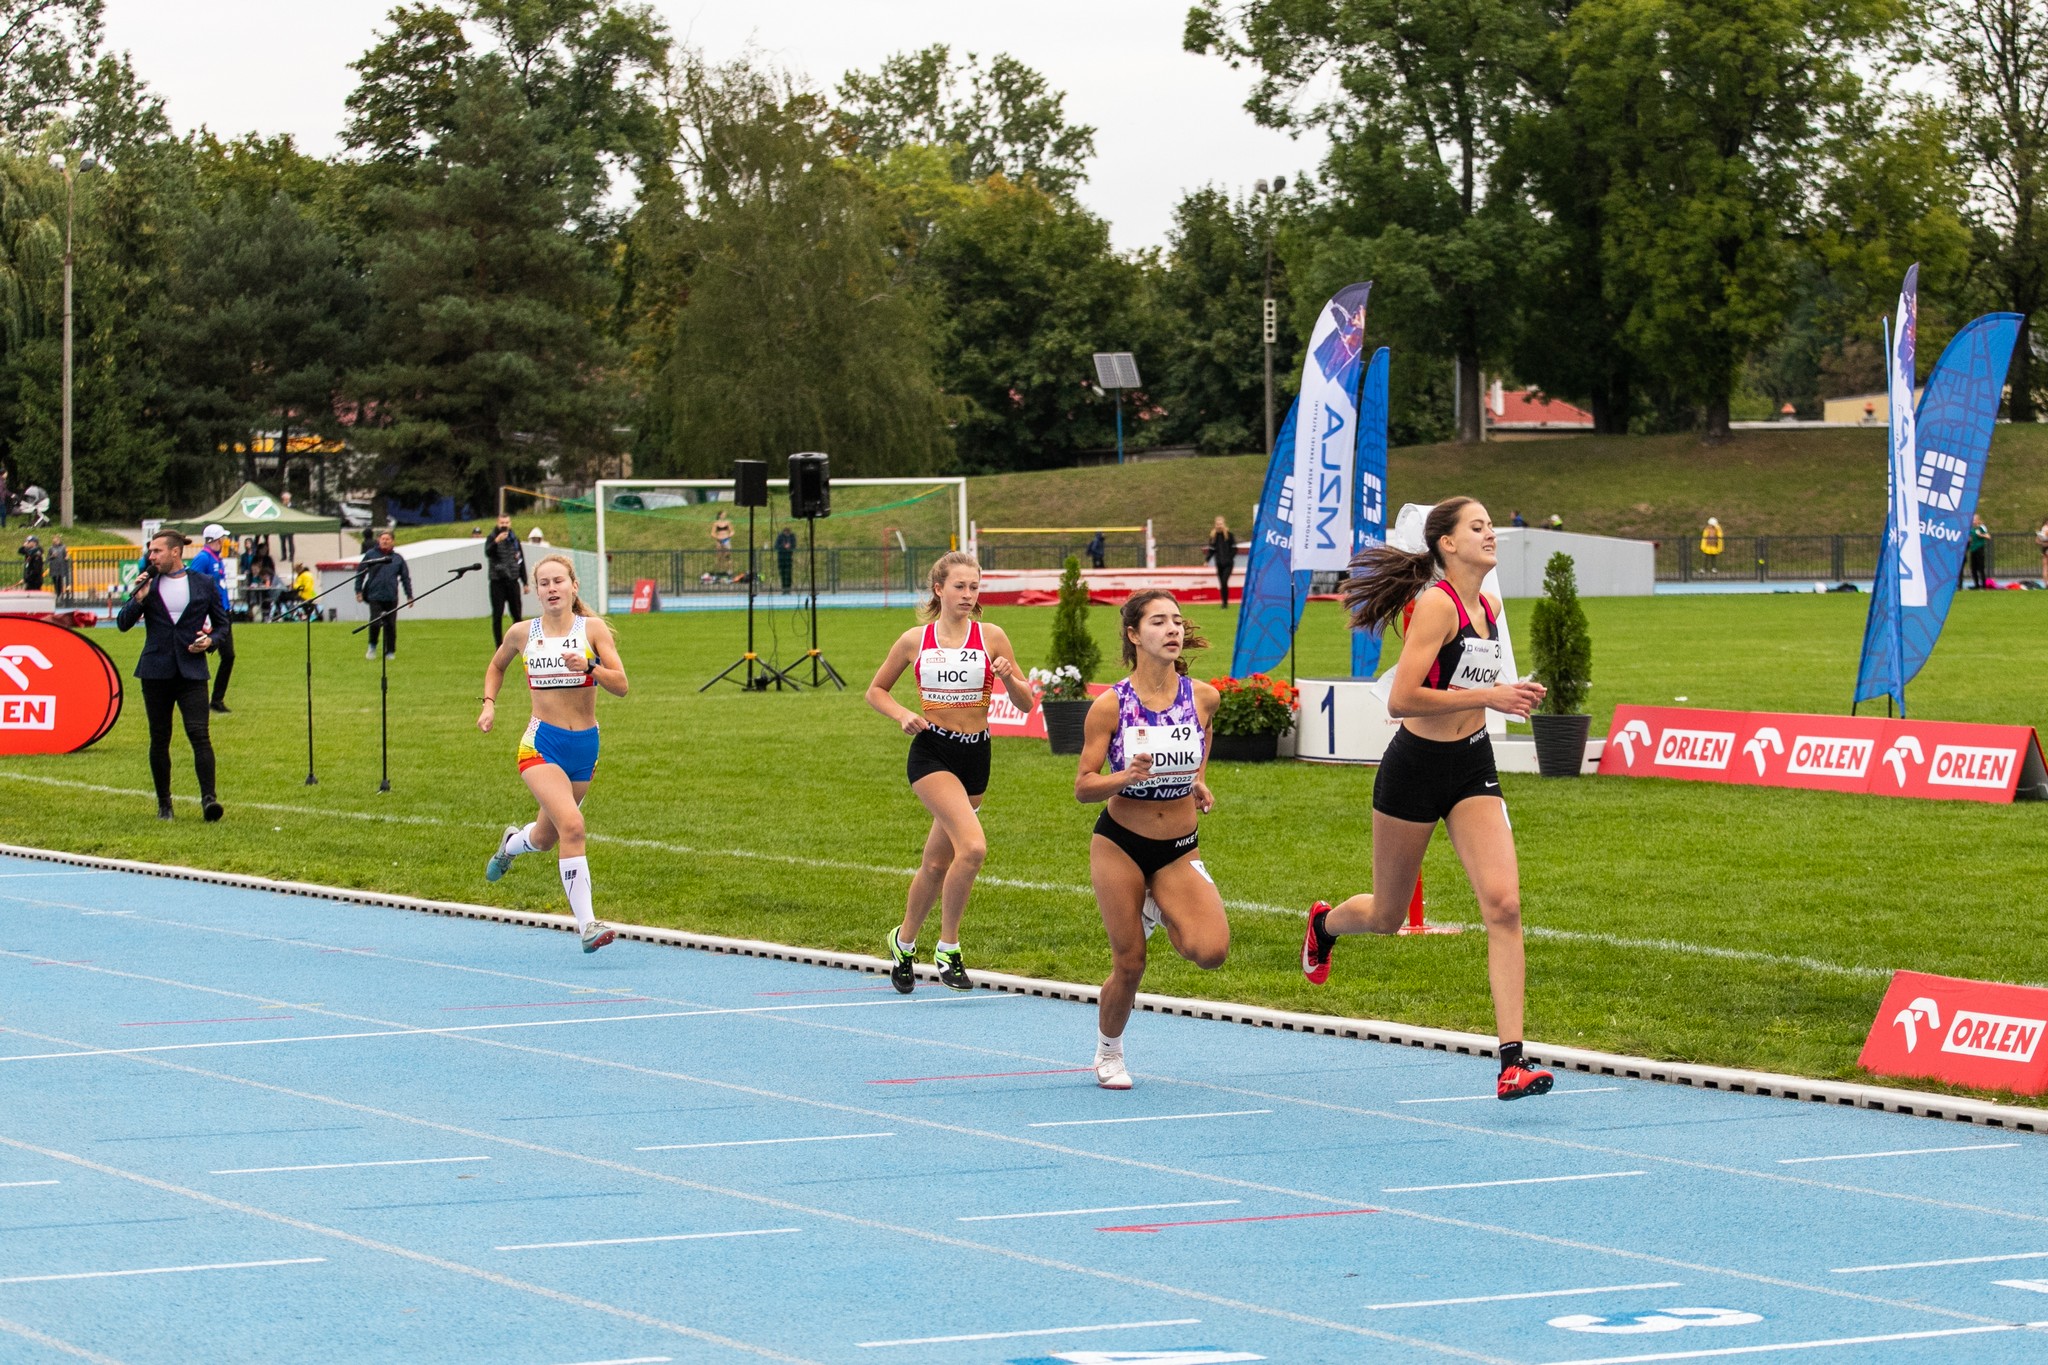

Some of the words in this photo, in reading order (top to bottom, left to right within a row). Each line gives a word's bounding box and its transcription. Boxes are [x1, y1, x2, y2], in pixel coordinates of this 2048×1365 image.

[1919, 518, 1961, 542] aków
[562, 638, 578, 649] 41
[529, 656, 568, 669] RATAJC
[960, 650, 977, 662] 24
[535, 677, 563, 685] KRAKÓW
[937, 670, 968, 682] HOC
[928, 693, 959, 701] KRAKÓW
[961, 693, 978, 701] 2022
[3, 701, 46, 723] EN
[1321, 686, 1335, 754] 1
[950, 731, 980, 743] PRO
[1170, 726, 1192, 741] 49
[1662, 735, 1728, 762] ORLEN
[1796, 743, 1866, 770] ORLEN
[1937, 752, 2008, 781] ORLEN
[1153, 785, 1189, 799] NIKE
[1175, 834, 1195, 848] NIKE
[1952, 1018, 2038, 1055] ORLEN
